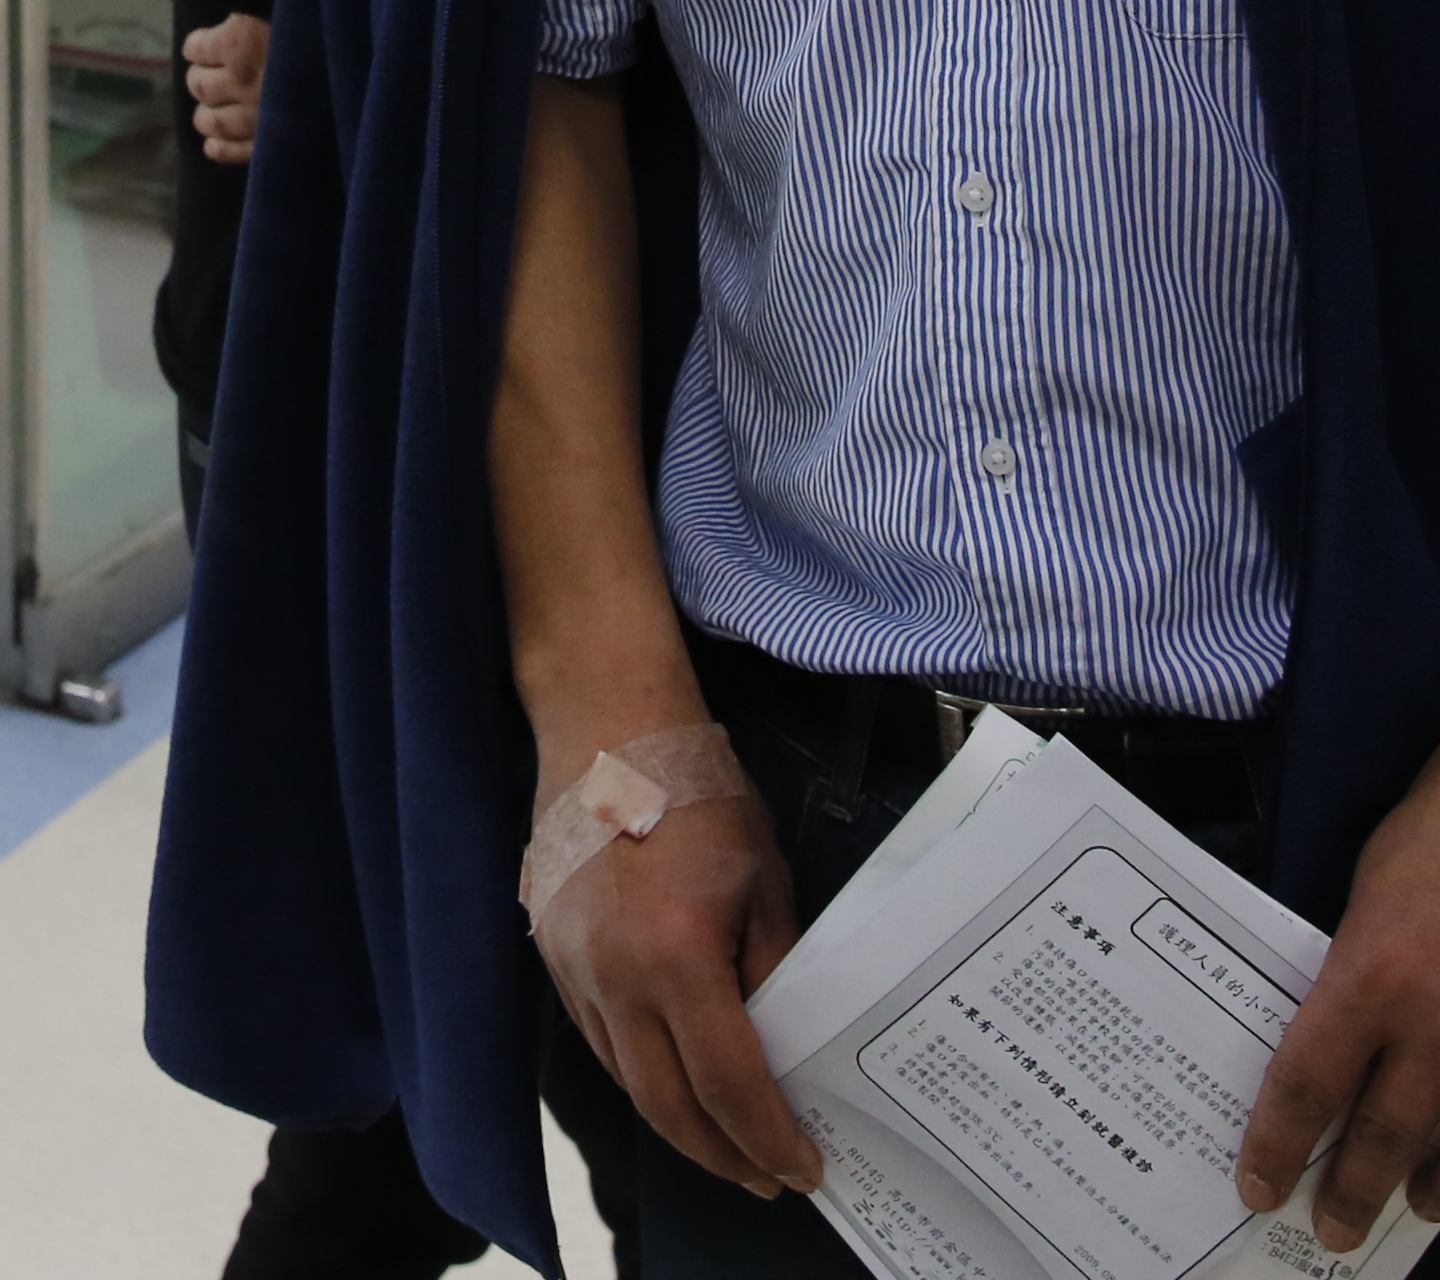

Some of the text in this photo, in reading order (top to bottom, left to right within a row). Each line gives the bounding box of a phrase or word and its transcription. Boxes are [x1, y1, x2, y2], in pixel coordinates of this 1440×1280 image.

[1049, 897, 1117, 958] 注意事項
[945, 990, 1157, 1179] 如果有下列情形請立刻就醫複診
